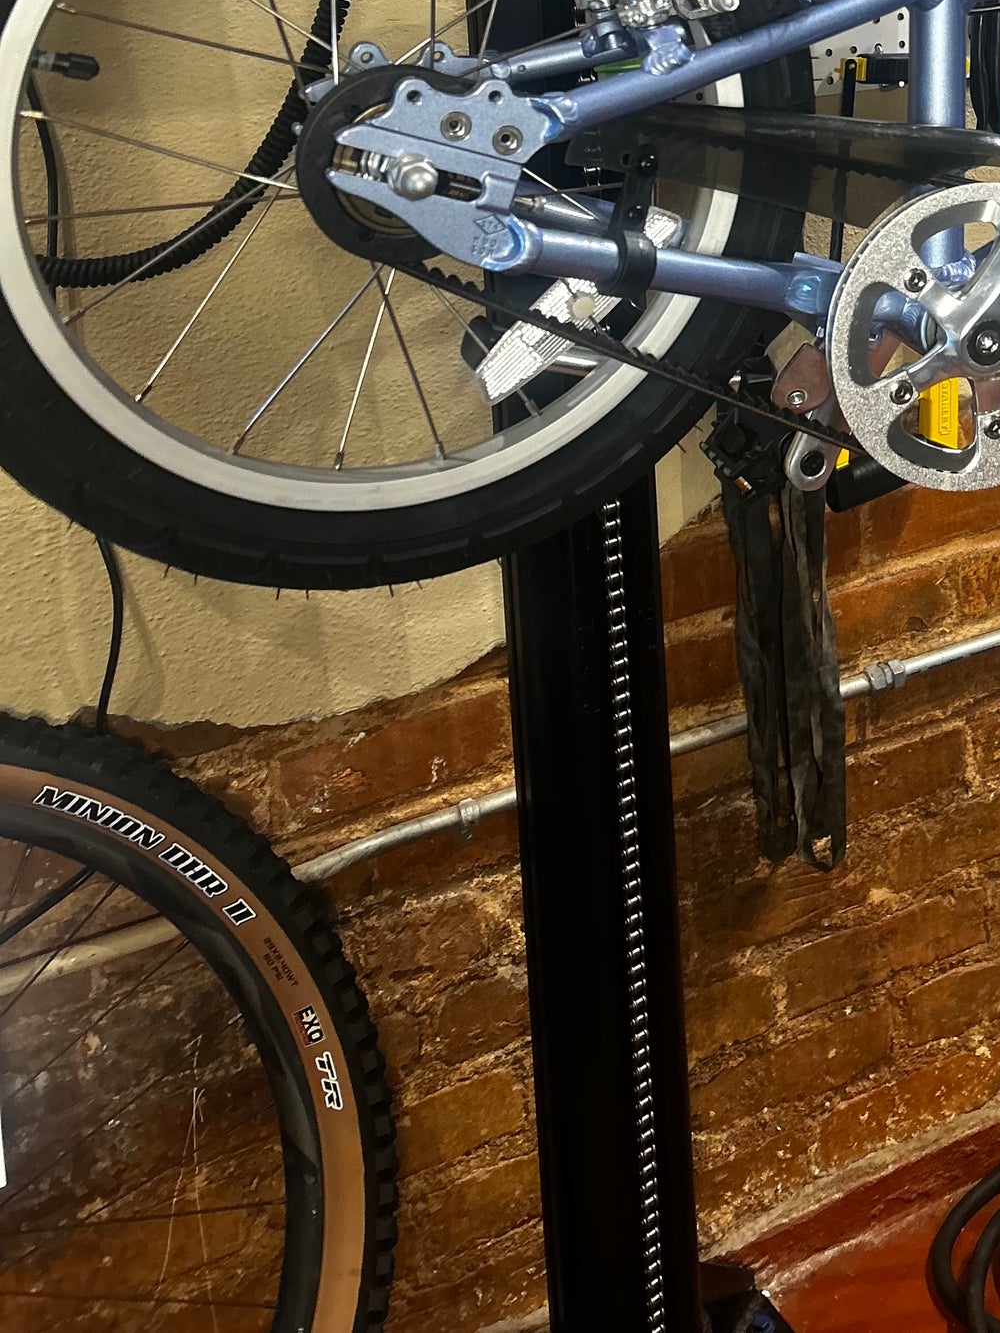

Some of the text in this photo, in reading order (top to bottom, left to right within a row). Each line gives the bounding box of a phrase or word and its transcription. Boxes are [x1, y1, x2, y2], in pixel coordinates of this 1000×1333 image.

[32, 785, 256, 926] MINION DHR II
[301, 1006, 325, 1043] EXO
[315, 1051, 344, 1111] TR
